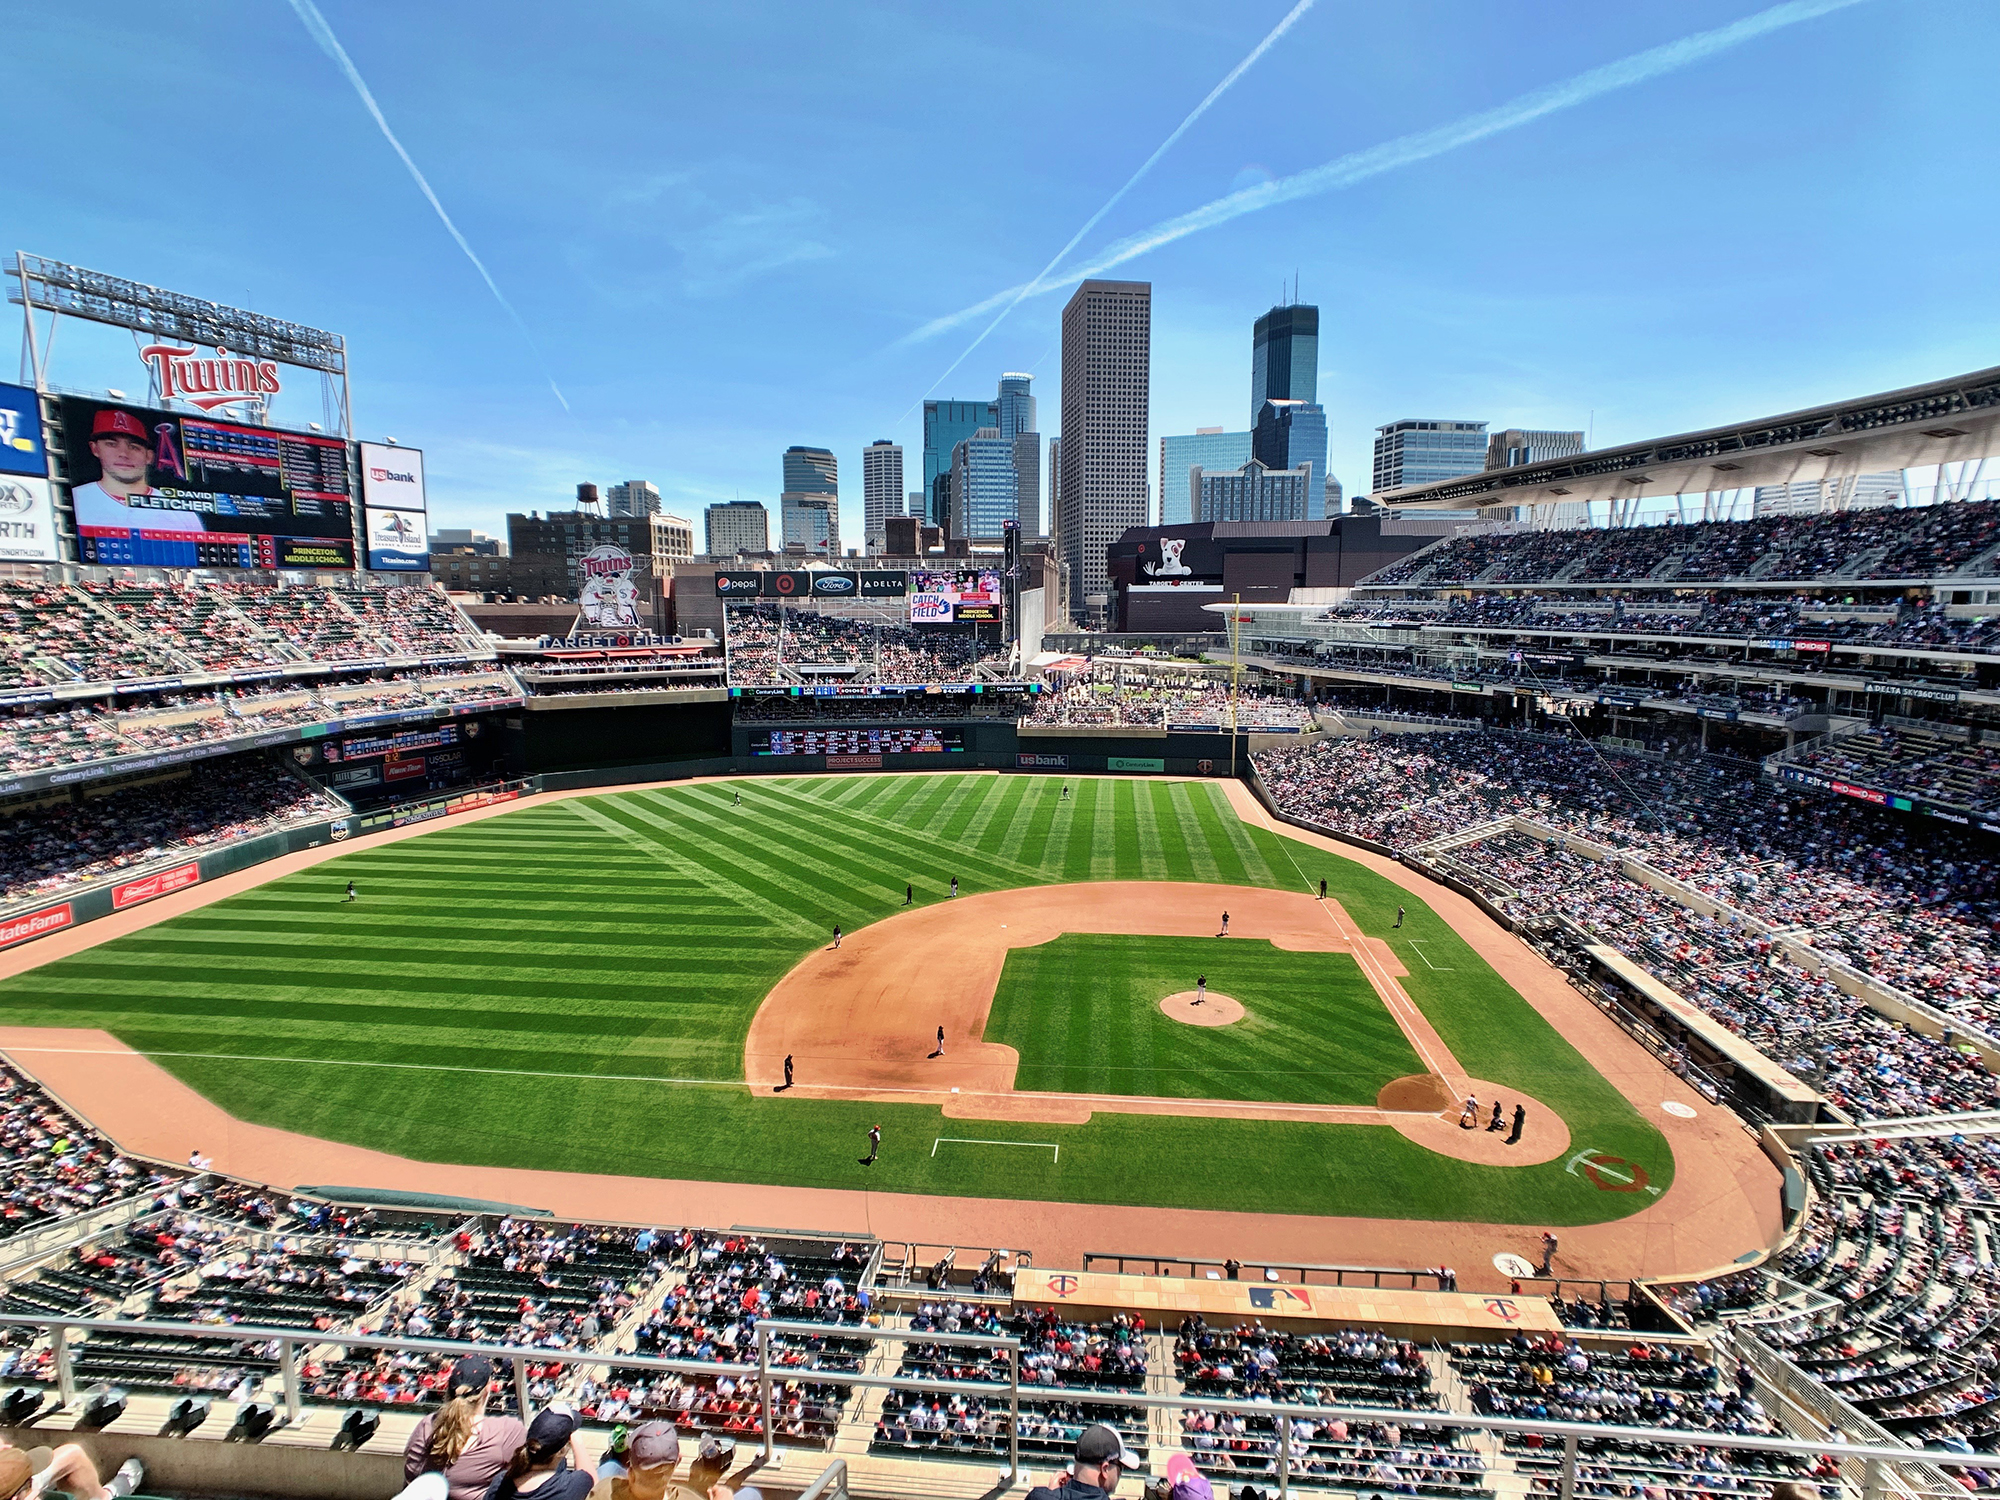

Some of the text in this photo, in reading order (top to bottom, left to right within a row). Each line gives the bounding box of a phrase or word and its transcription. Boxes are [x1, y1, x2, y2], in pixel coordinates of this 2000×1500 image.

[140, 346, 281, 401] Twins
[176, 490, 212, 499] DAVID
[130, 496, 214, 512] FLETCHER
[374, 531, 422, 544] Treasure Island
[292, 548, 336, 556] PRINCETON
[315, 556, 345, 564] SCHOOL
[580, 553, 633, 579] Twins
[731, 579, 757, 589] pepsi
[822, 579, 846, 590] Ford
[874, 580, 903, 588] DELTA
[912, 595, 940, 604] CATCH
[912, 608, 938, 618] FIELD
[540, 636, 684, 649] TARGET FIELD
[1875, 686, 1901, 694] DELTA
[1936, 692, 1956, 701] CLUB
[254, 734, 286, 746] CenturyLink
[50, 766, 105, 784] CenturyLink
[111, 758, 156, 772] Technology
[157, 752, 184, 764] Partner
[186, 750, 194, 758] of
[195, 748, 206, 756] the
[162, 873, 175, 883] THIS
[162, 881, 174, 891] FOR
